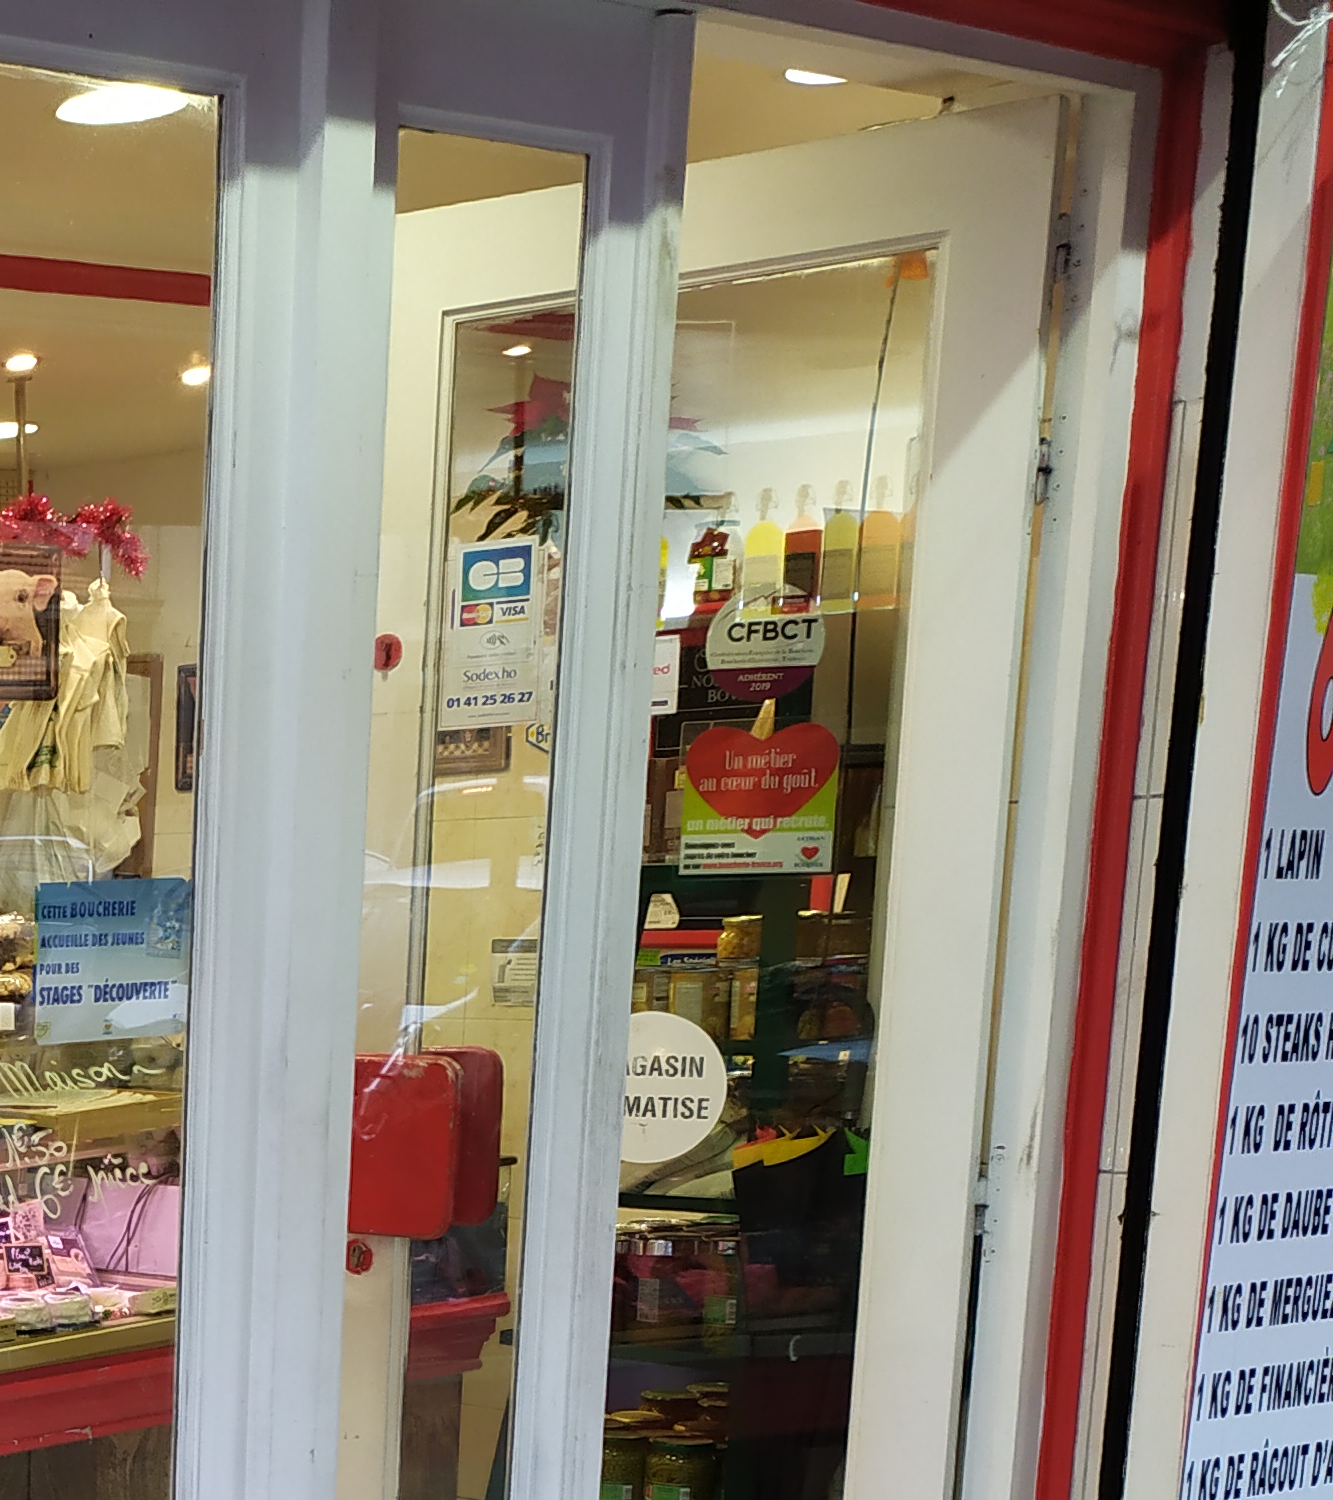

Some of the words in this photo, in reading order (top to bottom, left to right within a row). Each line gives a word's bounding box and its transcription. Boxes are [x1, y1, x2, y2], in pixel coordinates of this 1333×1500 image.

[468, 556, 525, 591] CB
[500, 604, 526, 617] VISA
[727, 618, 819, 643] CFBCT
[462, 666, 518, 683] Sodexho
[749, 682, 771, 691] 2019
[446, 697, 461, 709] 01
[464, 695, 479, 707] 41
[481, 693, 497, 706] 25
[500, 692, 515, 705] 26
[518, 690, 534, 703] 27
[724, 750, 744, 770] Un
[747, 748, 797, 769] métier
[699, 776, 717, 792] au
[720, 775, 757, 791] cœur
[761, 769, 780, 790] du
[752, 814, 774, 831] qui
[1263, 827, 1274, 881] 1
[1275, 827, 1326, 881] LAPIN
[41, 905, 68, 919] CETTE
[69, 900, 137, 919] BOUCHERIE
[40, 934, 90, 949] ACCUEILLE
[91, 933, 110, 948] DES
[111, 931, 145, 947] JEUNES
[1251, 921, 1262, 972] 1
[1264, 921, 1289, 973] KG
[1291, 921, 1315, 972] DE
[39, 963, 63, 975] POUR
[64, 962, 80, 974] DES
[38, 985, 83, 1006] STAGES
[1240, 1013, 1260, 1065] 10
[1262, 1011, 1324, 1064] STEAKS
[1229, 1105, 1239, 1156] 1
[1240, 1103, 1266, 1155] KG
[1272, 1102, 1296, 1153] DE
[1217, 1195, 1228, 1246] 1
[1230, 1192, 1254, 1245] KG
[1257, 1192, 1280, 1242] DE
[1281, 1188, 1333, 1240] DAUBE
[1206, 1285, 1217, 1335] 1
[1219, 1282, 1244, 1333] KG
[1245, 1280, 1268, 1330] DE
[1269, 1273, 1333, 1327] MERGUE
[1196, 1372, 1206, 1423] 1
[1208, 1368, 1232, 1421] KG
[1234, 1367, 1257, 1416] DE
[1247, 1437, 1311, 1498] RÂGOUT
